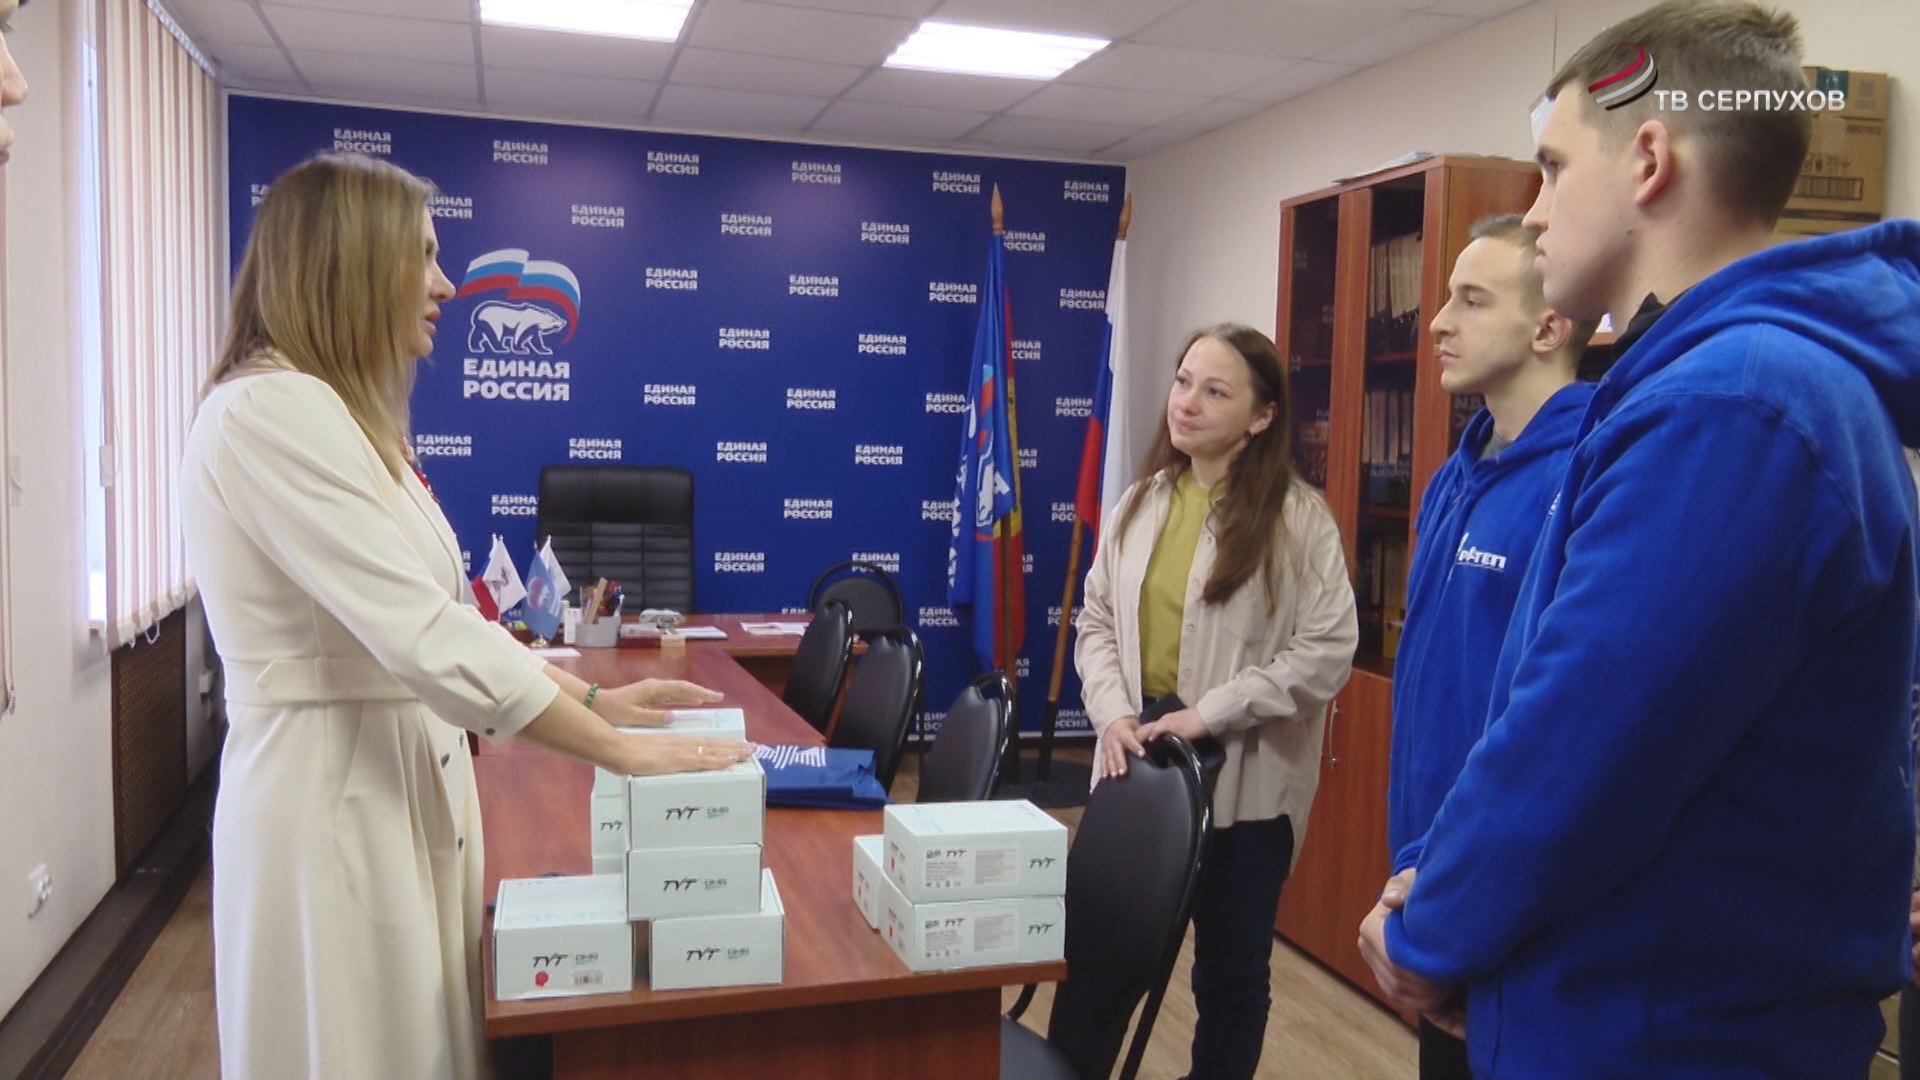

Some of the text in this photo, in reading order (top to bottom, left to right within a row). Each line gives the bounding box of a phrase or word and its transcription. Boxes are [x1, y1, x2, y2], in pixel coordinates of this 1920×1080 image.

[334, 128, 391, 142] ЕДИНАЯ
[334, 141, 391, 155] РОССИЯ
[494, 140, 548, 153] ЕДИНАЯ
[494, 152, 548, 165] РОССИЯ
[647, 151, 699, 164] ЕДИНАЯ
[647, 163, 699, 176] РОССИЯ
[792, 161, 840, 174] ЕДИНАЯ
[792, 172, 840, 185] РОССИЯ
[933, 171, 980, 183] ЕДИНАЯ
[933, 182, 980, 194] РОССИЯ
[1064, 180, 1109, 192] ЕДИНАЯ
[430, 195, 472, 207] ИНАЯ
[1064, 191, 1109, 203] РОССИЯ
[428, 206, 472, 218] ОССИЯ
[572, 204, 624, 216] ЕДИНАЯ
[572, 216, 624, 228] РОССИЯ
[721, 213, 772, 226] ЕДИНАЯ
[721, 224, 772, 237] РОССИЯ
[861, 221, 909, 234] ЕДИНАЯ
[861, 232, 909, 245] РОССИЯ
[1003, 231, 1045, 241] ДИНАЯ
[1003, 241, 1045, 252] ОССИЯ
[646, 266, 698, 279] ЕДИНАЯ
[646, 278, 698, 291] РОССИЯ
[789, 274, 839, 286] ЕДИНАЯ
[789, 285, 839, 297] РОССИЯ
[929, 281, 977, 294] ЕДИНАЯ
[1060, 287, 1105, 300] ЕДИНАЯ
[929, 292, 977, 305] РОССИЯ
[1060, 298, 1105, 311] РОССИЯ
[719, 327, 770, 340] ЕДИНАЯ
[858, 333, 906, 345] ЕДИНАЯ
[719, 338, 770, 351] РОССИЯ
[858, 344, 906, 356] РОССИЯ
[1011, 340, 1041, 349] ИНАЯ
[1011, 350, 1041, 360] ССИЯ
[464, 358, 570, 380] ЕДИНАЯ
[464, 380, 570, 402] РОССИЯ
[644, 383, 696, 395] ЕДИНАЯ
[787, 387, 836, 400] ЕДИНАЯ
[644, 394, 696, 406] РОССИЯ
[926, 393, 966, 403] ЕДИНА
[1056, 397, 1093, 407] ЕДИНА
[787, 398, 836, 411] РОССИЯ
[926, 403, 967, 413] РОССИ
[1056, 407, 1092, 417] РОССИ
[416, 434, 472, 445] ЕДИНАЯ
[569, 437, 622, 450] ЕДИНАЯ
[416, 446, 472, 457] РОССИЯ
[717, 441, 767, 453] ЕДИНАЯ
[855, 443, 903, 455] ЕДИНАЯ
[569, 448, 622, 461] РОССИЯ
[717, 452, 767, 464] РОССИЯ
[855, 454, 903, 466] РОССИЯ
[491, 494, 538, 505] ЕДИНА
[784, 497, 833, 509] ЕДИНАЯ
[922, 500, 953, 510] ЕДИН
[491, 505, 537, 516] РОССИ
[784, 508, 833, 520] РОССИЯ
[922, 511, 953, 521] РОСС
[714, 551, 764, 563] ЕДИНАЯ
[714, 562, 764, 574] РОССИЯ
[919, 617, 958, 627] РОССИ
[665, 806, 700, 820] TYT
[663, 878, 697, 890] TYT
[687, 946, 720, 960] TYT
[533, 953, 568, 968] TYT
